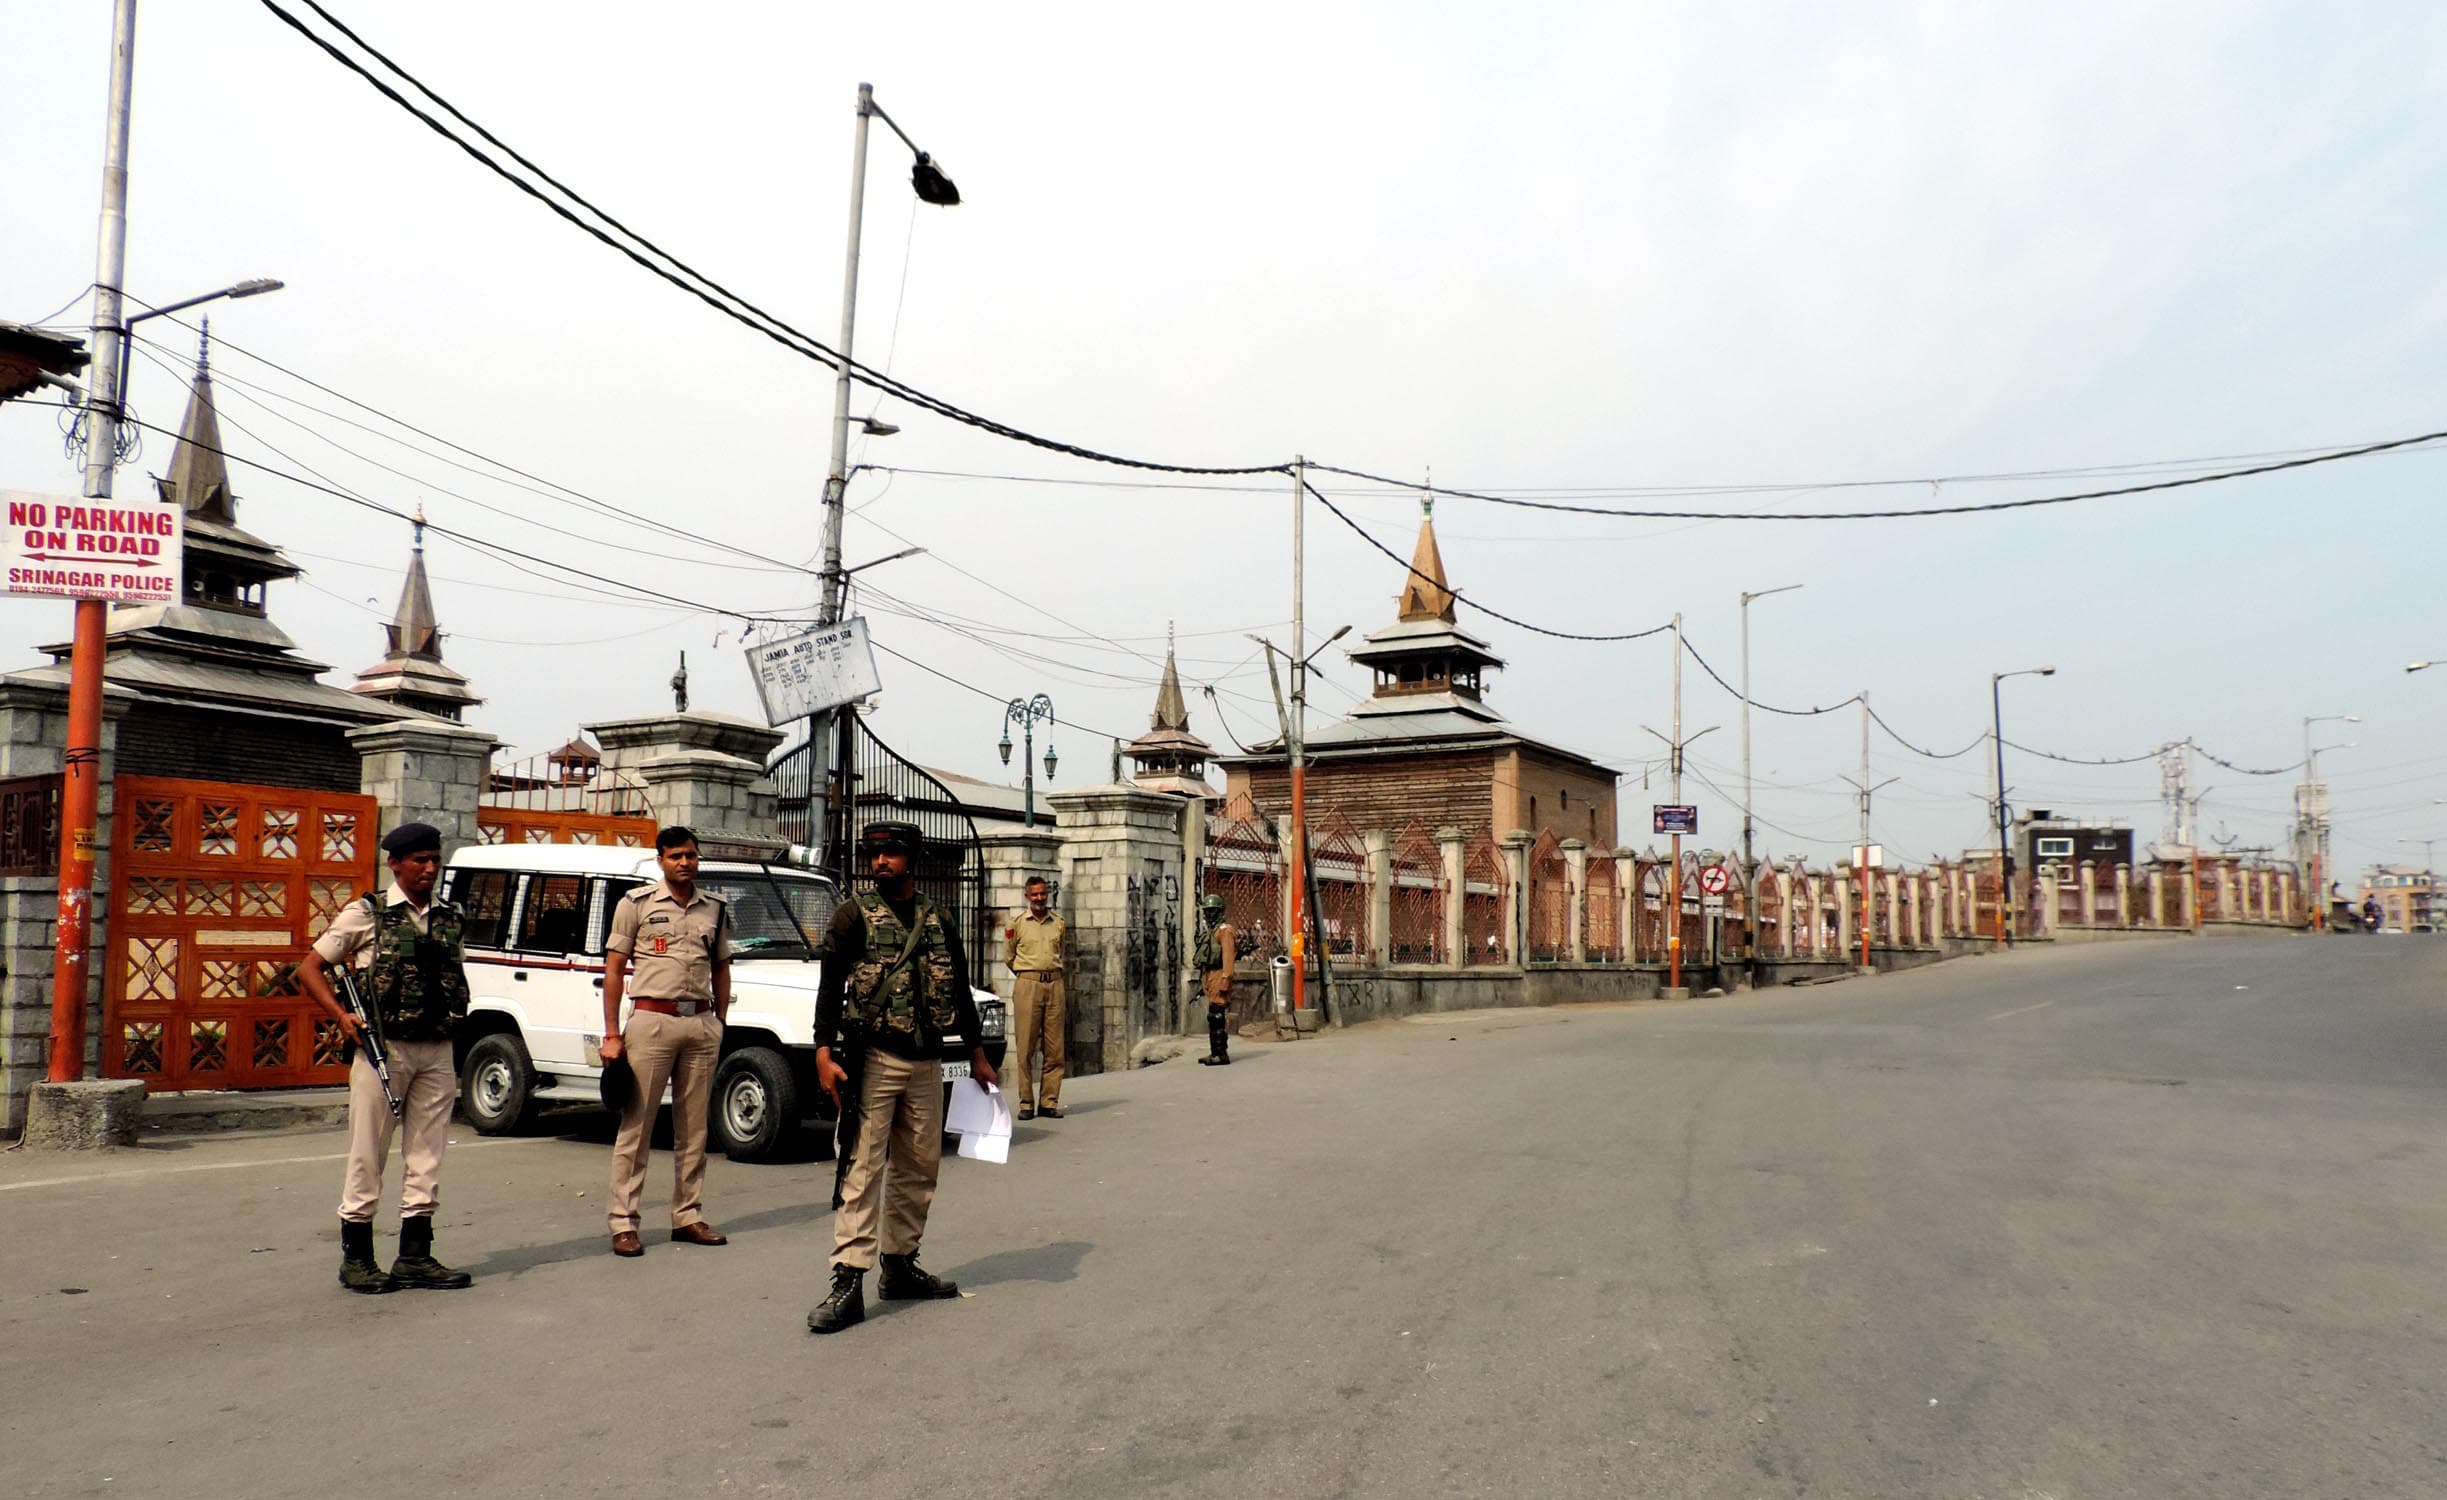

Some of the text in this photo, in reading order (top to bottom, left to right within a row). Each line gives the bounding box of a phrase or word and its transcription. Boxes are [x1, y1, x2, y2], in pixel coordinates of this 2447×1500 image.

[9, 502, 173, 537] NO PARKING
[24, 530, 160, 556] ON ROAD
[8, 567, 173, 592] SRINAGAR POLICE
[764, 648, 789, 662] JAMIA
[794, 641, 813, 654] AUTO
[816, 633, 838, 647] STAND
